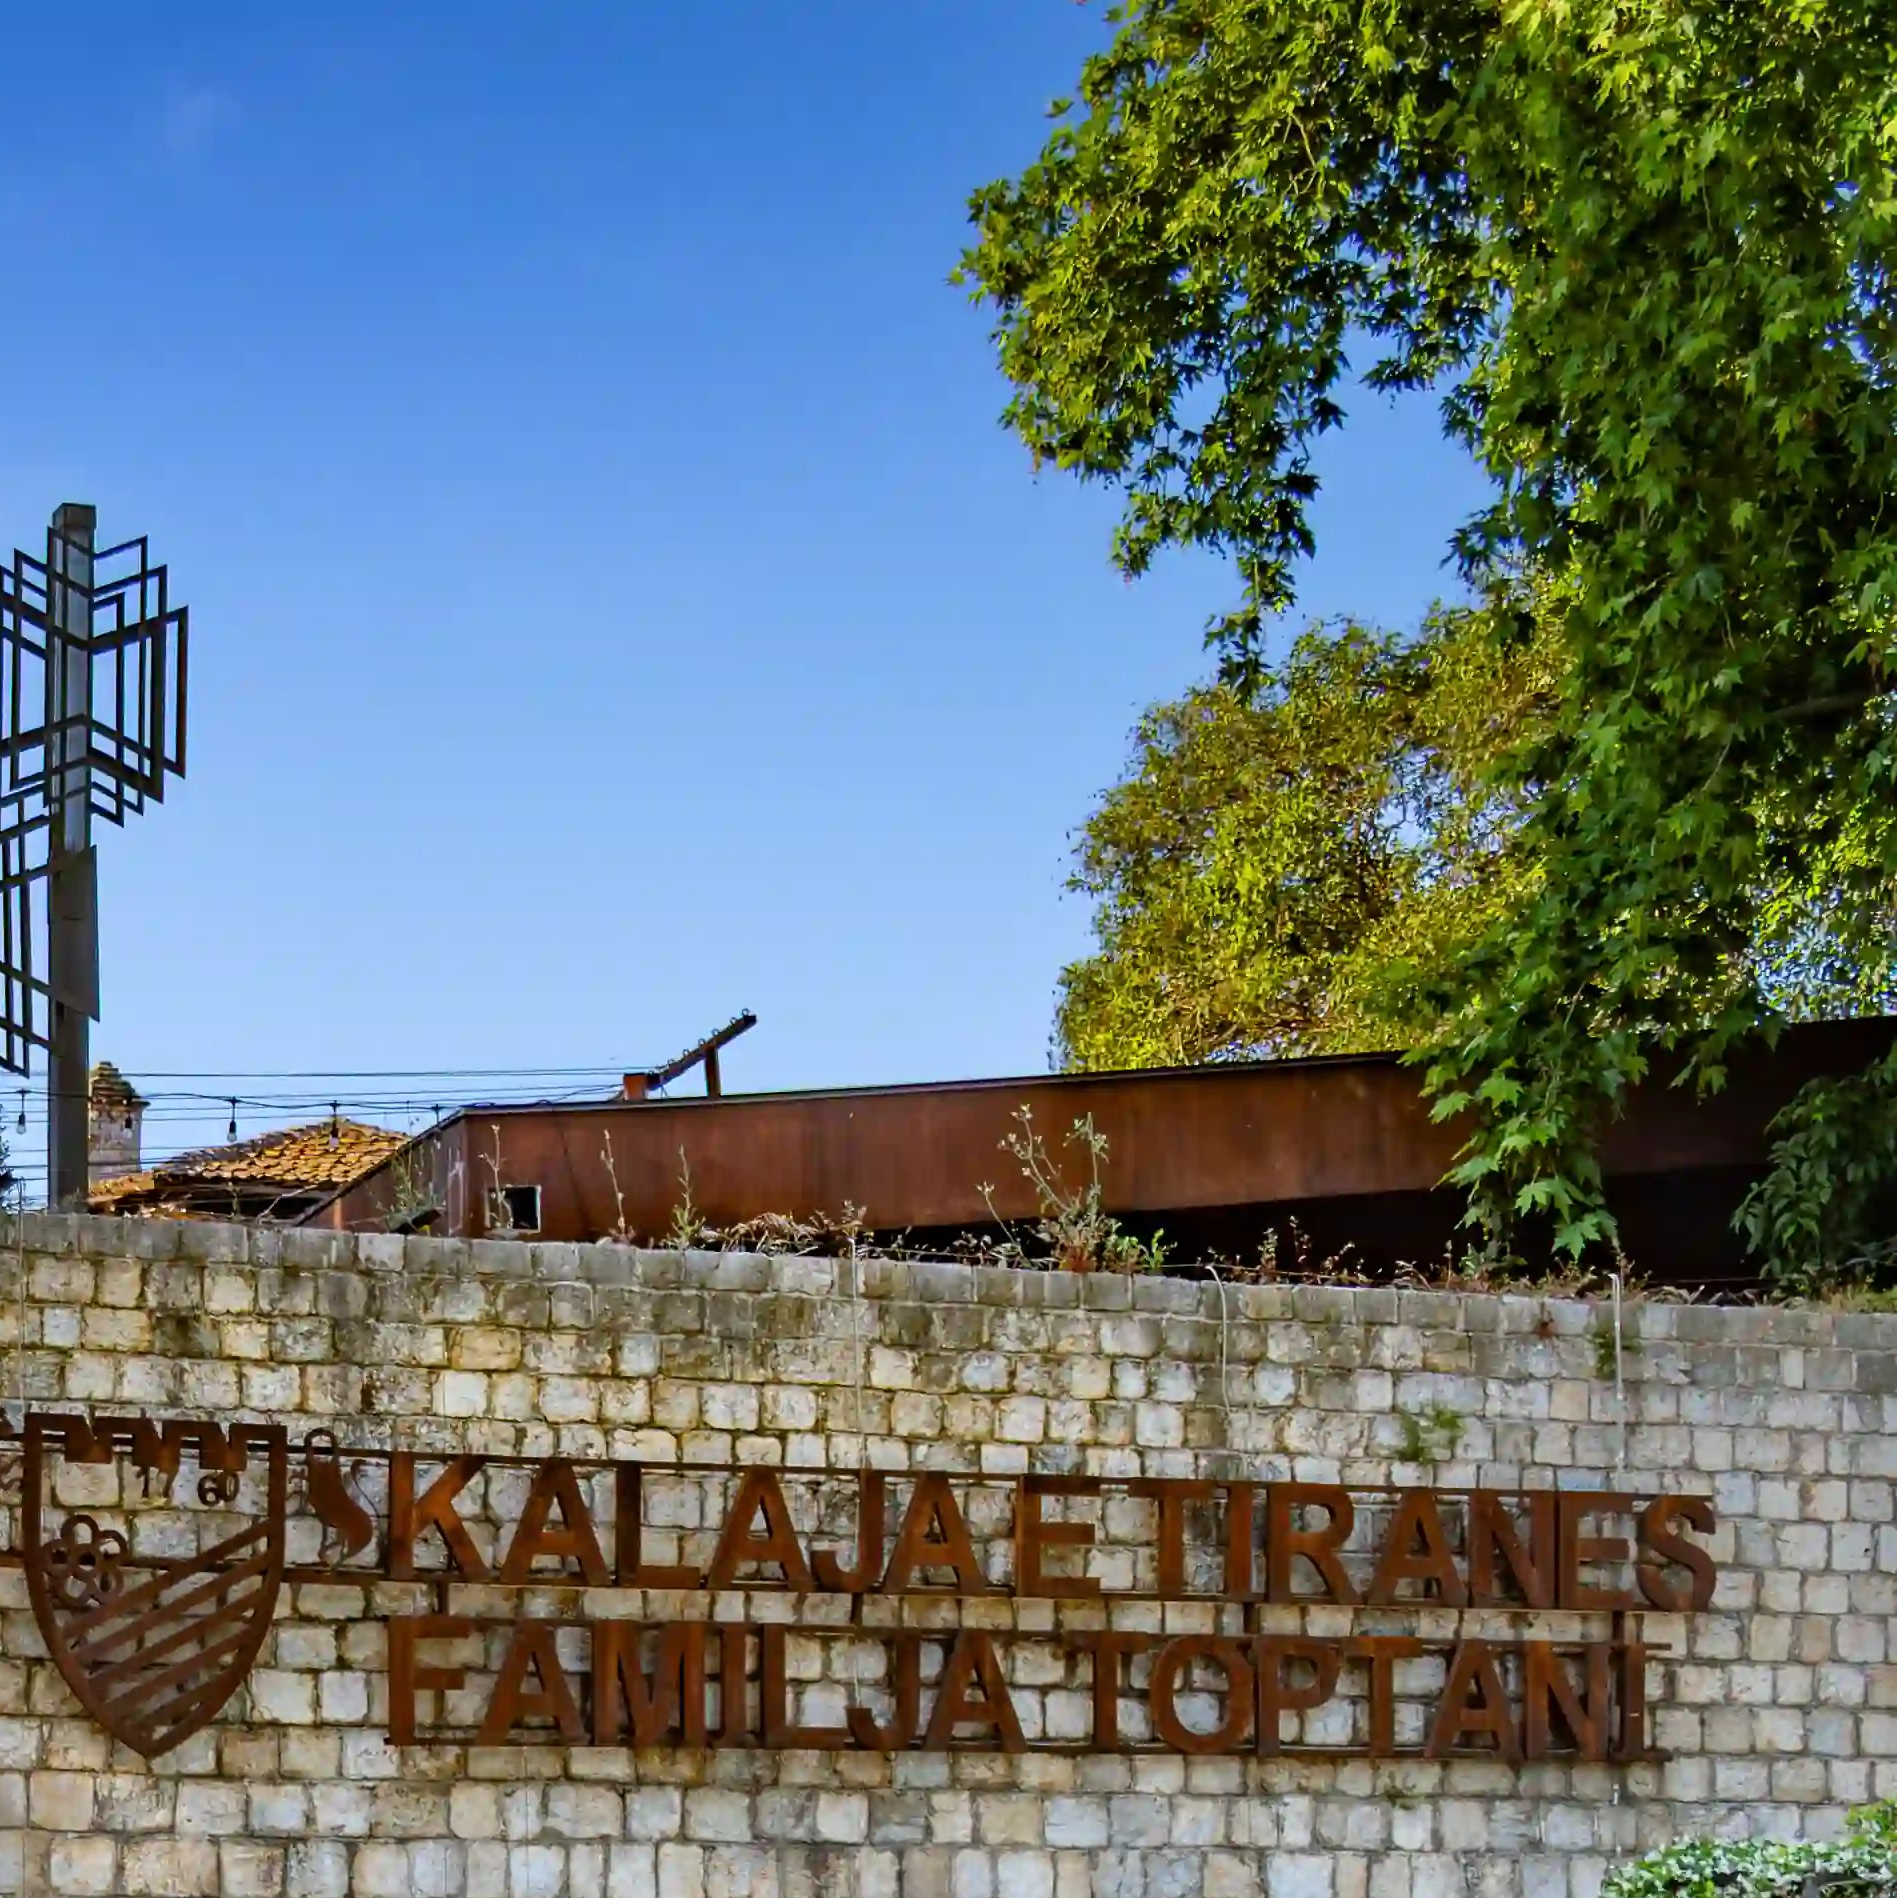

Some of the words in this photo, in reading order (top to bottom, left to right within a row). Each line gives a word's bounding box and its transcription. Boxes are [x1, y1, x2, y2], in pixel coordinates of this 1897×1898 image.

[389, 1452, 988, 1594] KALAJA
[1017, 1474, 1101, 1598] E
[1128, 1478, 1717, 1612] TIRANES
[389, 1615, 1026, 1754] FAMILJA
[1070, 1630, 1650, 1763] TOPTANI
